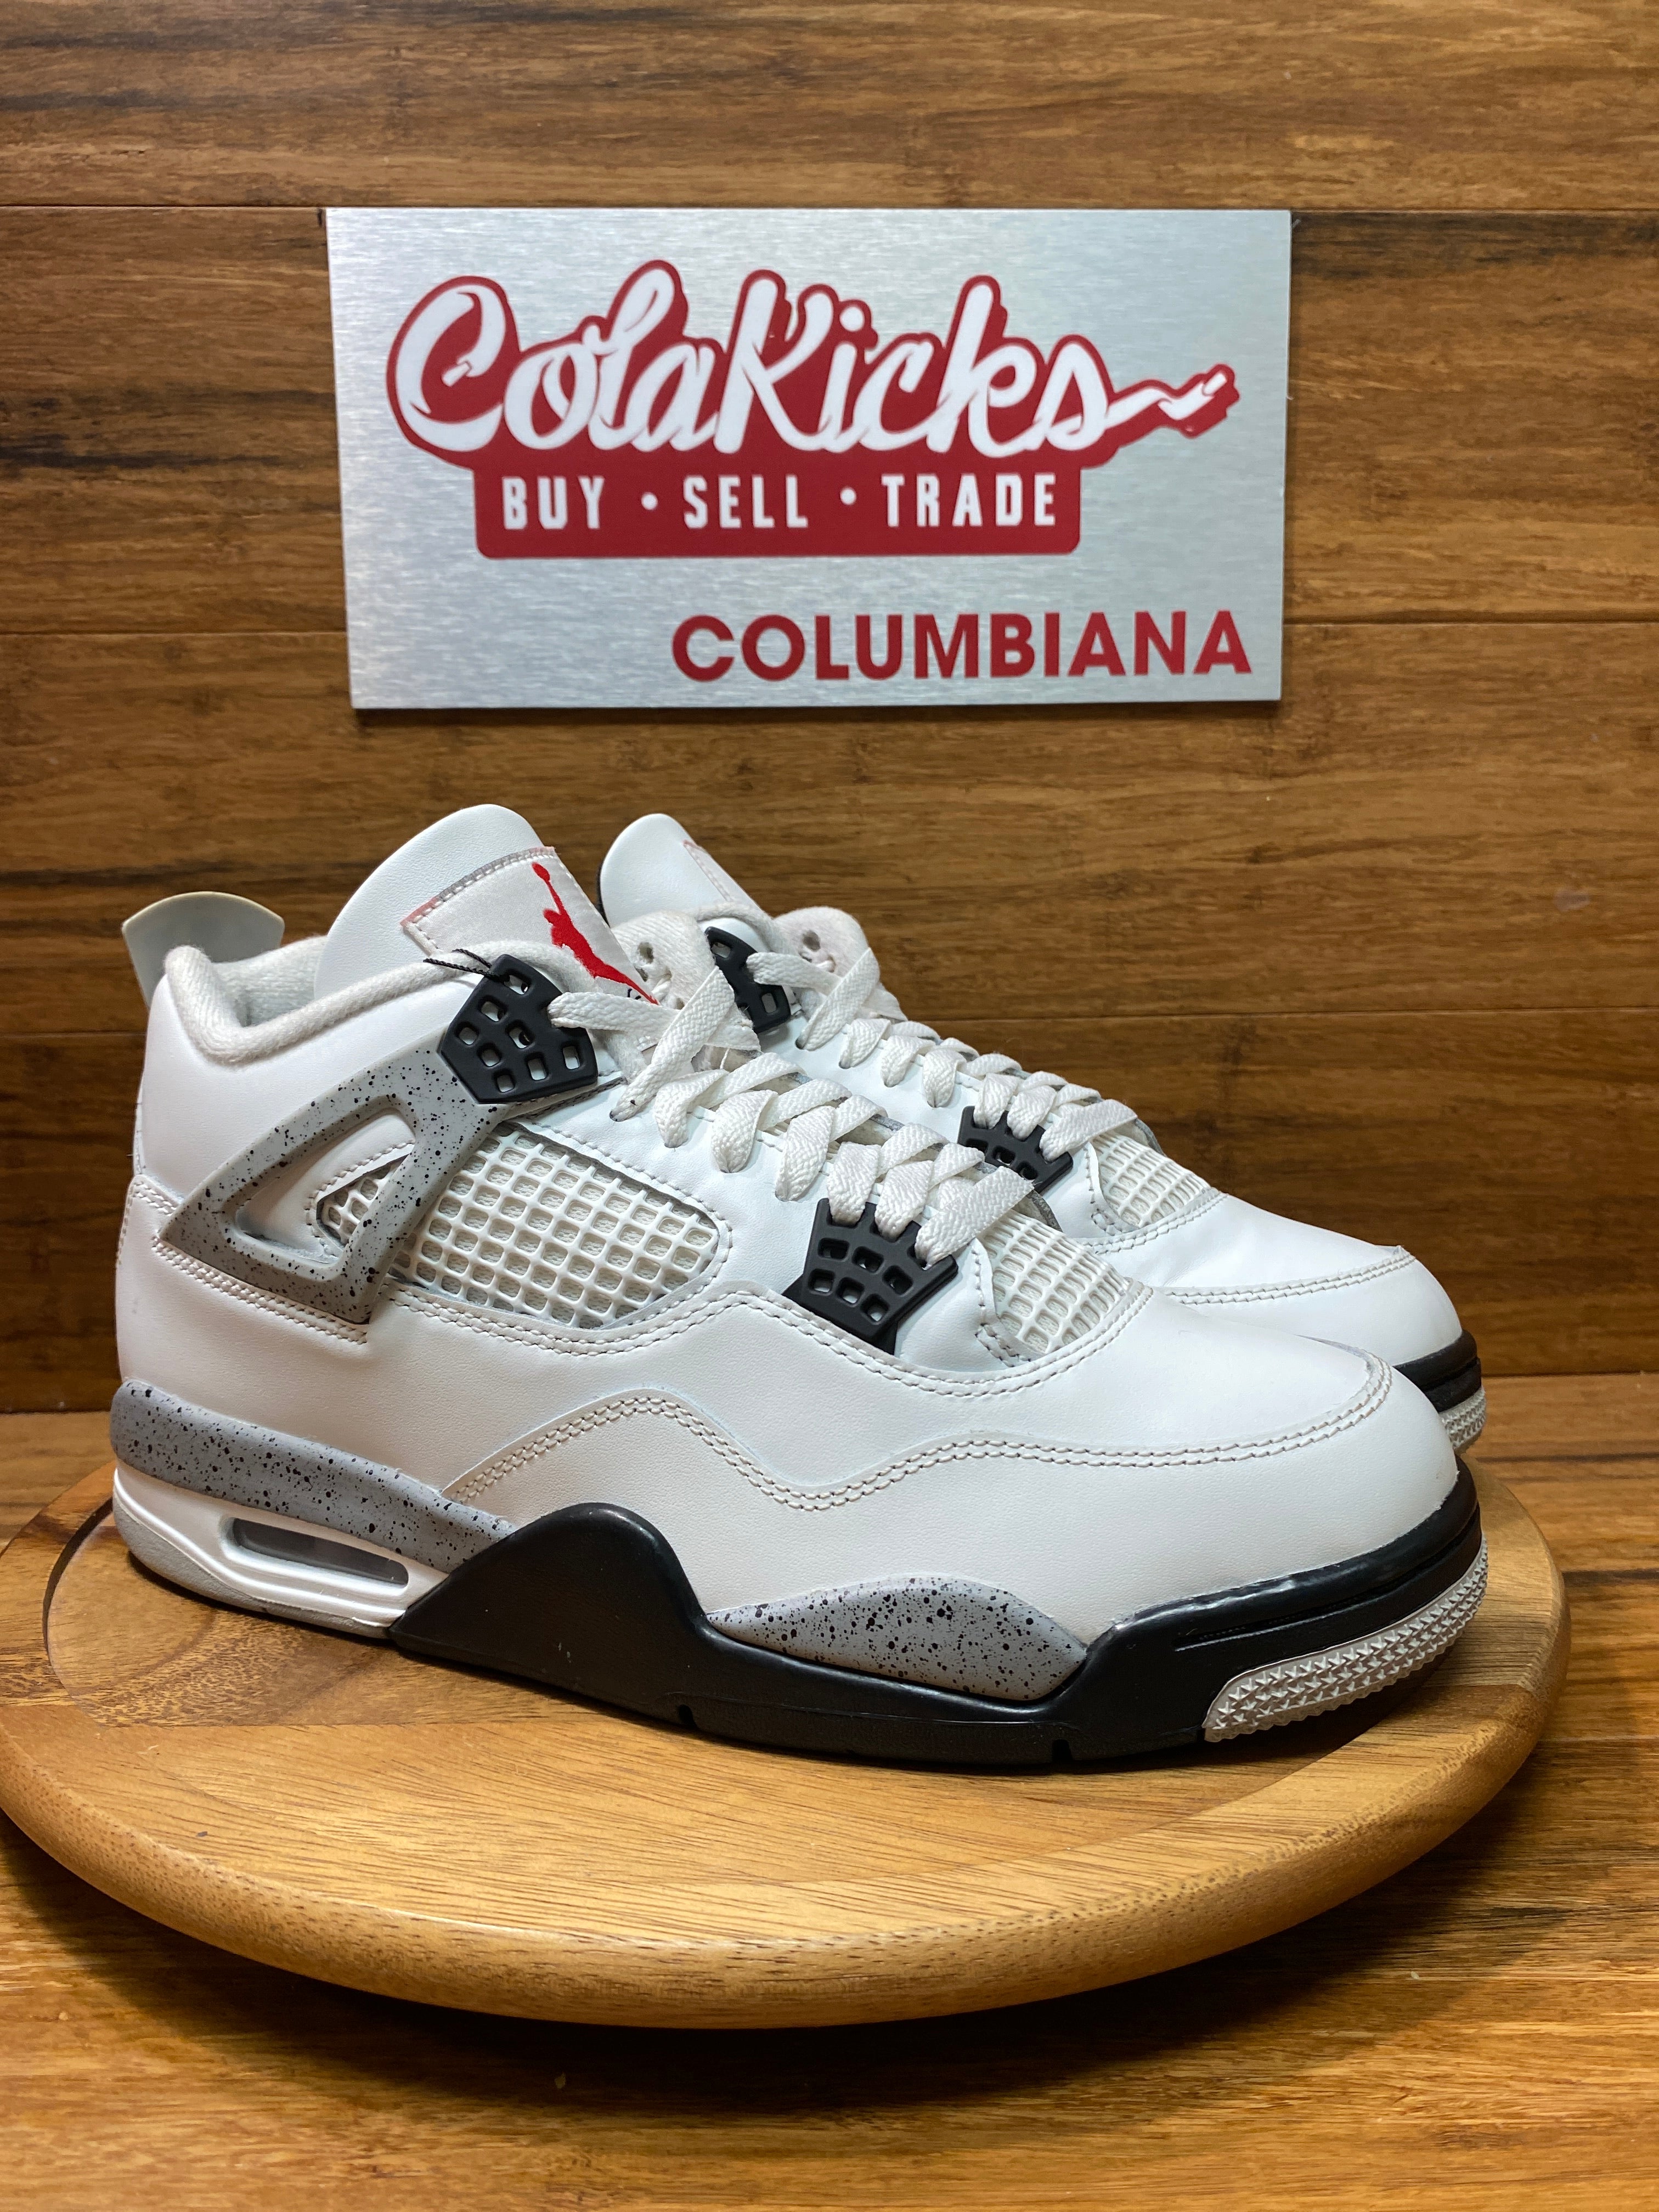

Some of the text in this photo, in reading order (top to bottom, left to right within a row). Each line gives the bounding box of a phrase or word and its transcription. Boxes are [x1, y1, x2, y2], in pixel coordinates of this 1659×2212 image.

[393, 264, 1228, 460] ColaKicks
[502, 473, 1056, 531] BUY SELL TRADE
[672, 610, 1252, 681] COLUMBIANA
